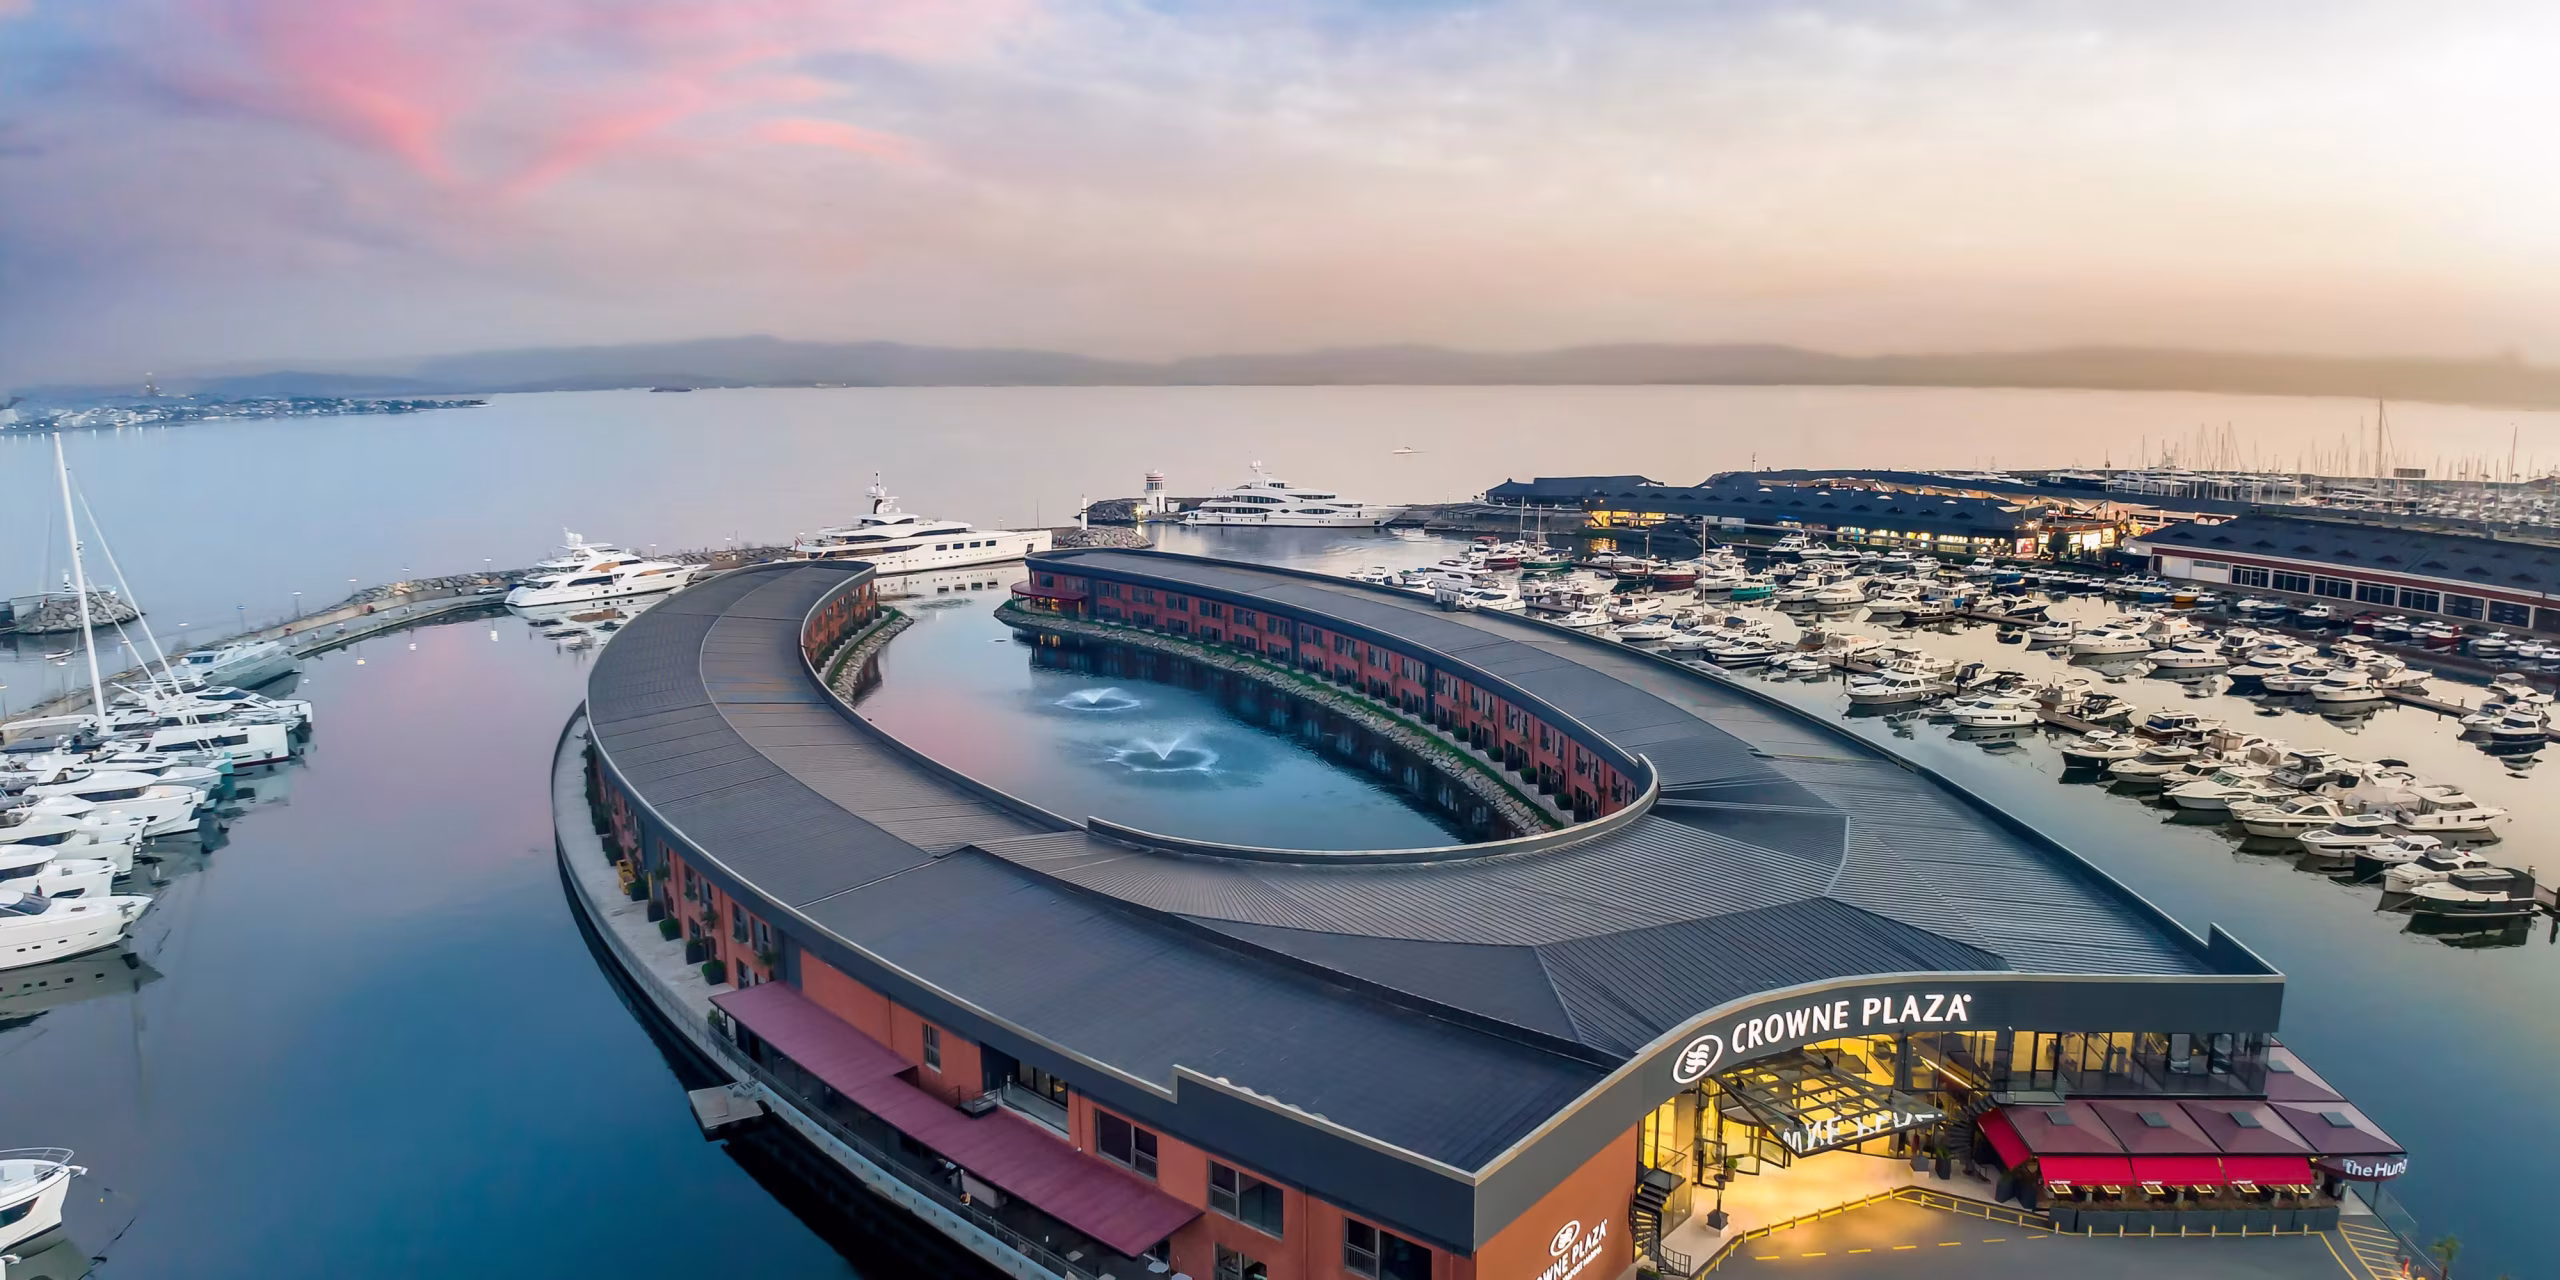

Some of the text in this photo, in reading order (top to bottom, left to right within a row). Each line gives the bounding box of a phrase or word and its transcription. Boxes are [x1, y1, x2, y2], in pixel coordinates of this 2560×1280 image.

[1732, 994, 1969, 1054] CROWNE PLAZA
[2345, 1160, 2373, 1176] the
[1536, 1219, 1607, 1280] WNE PLAZA
